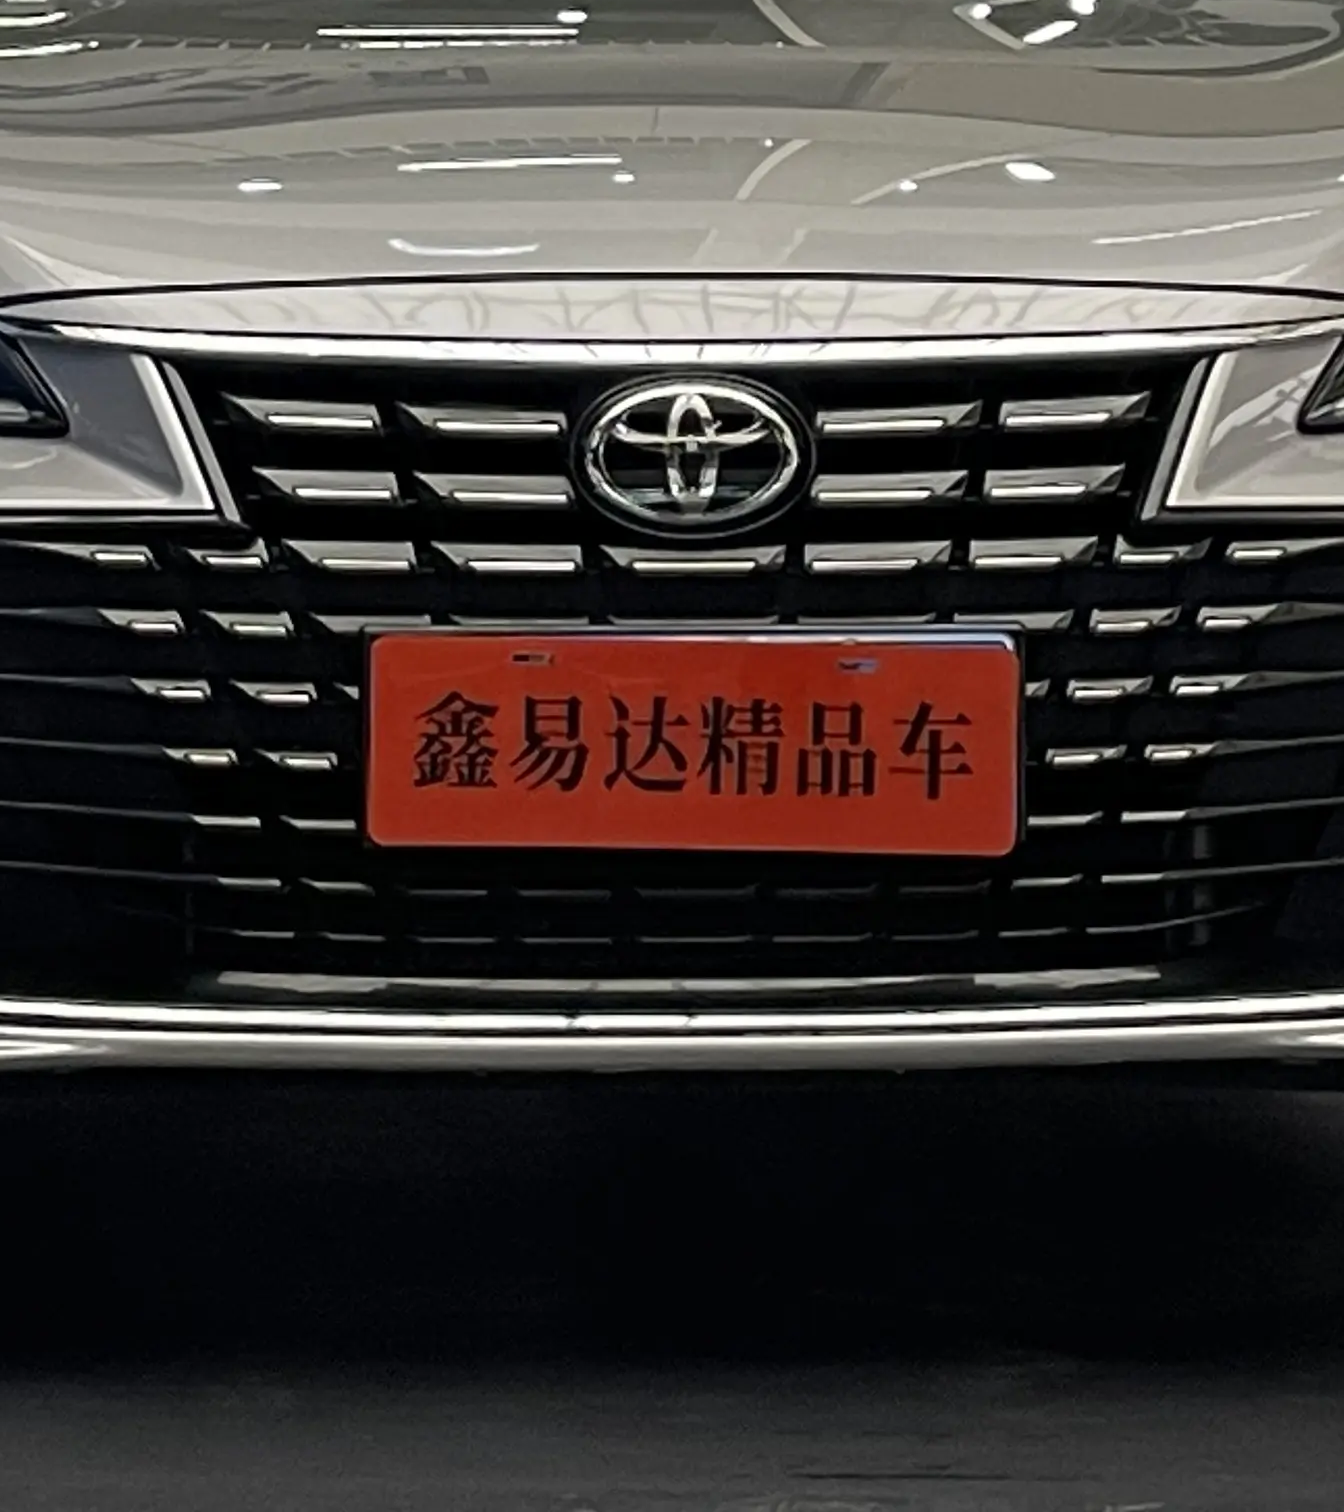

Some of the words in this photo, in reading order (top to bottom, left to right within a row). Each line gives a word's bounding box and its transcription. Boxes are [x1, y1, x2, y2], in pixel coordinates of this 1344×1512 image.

[412, 690, 975, 801] 鑫易达精品车
